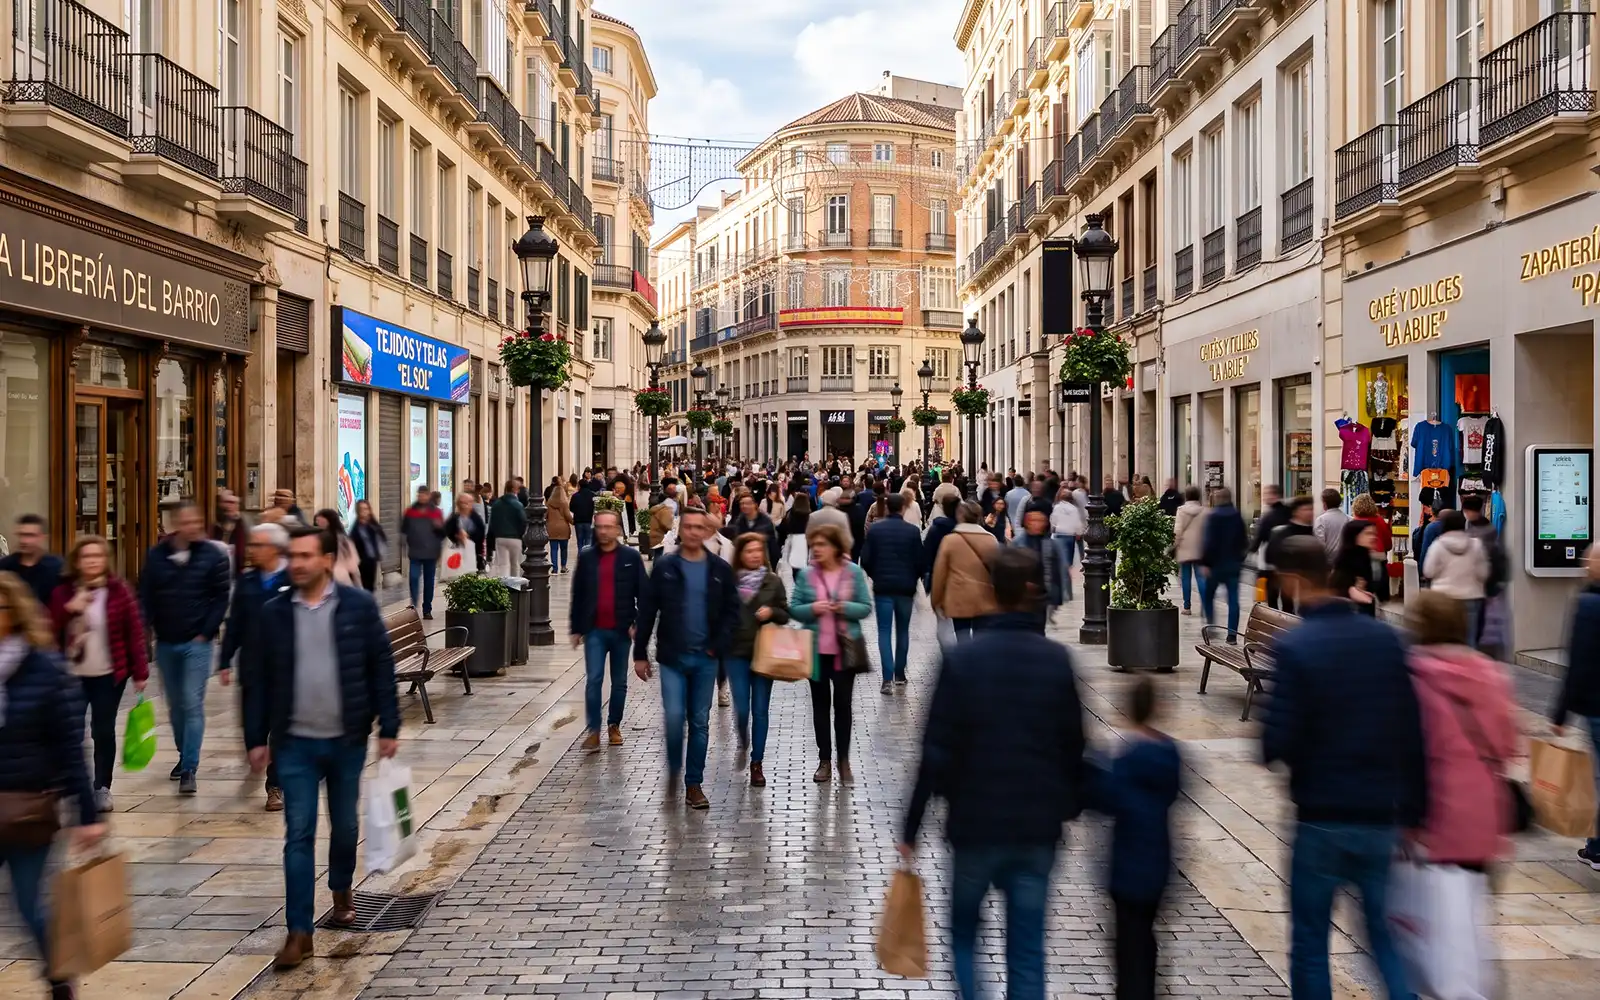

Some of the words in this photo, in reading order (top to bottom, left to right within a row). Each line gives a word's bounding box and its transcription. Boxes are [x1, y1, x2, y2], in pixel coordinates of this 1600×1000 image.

[1520, 224, 1600, 281] ZAPATERÍ
[21, 239, 117, 302] LIBRERÍA
[123, 268, 157, 312] DEL
[162, 280, 220, 326] BARRIO
[1368, 288, 1397, 322] CAFÉ
[1399, 291, 1409, 313] Y
[1410, 275, 1463, 311] DULCES
[375, 327, 414, 361] TEJIDOS
[414, 341, 422, 362] Y
[423, 342, 447, 369] TELAS
